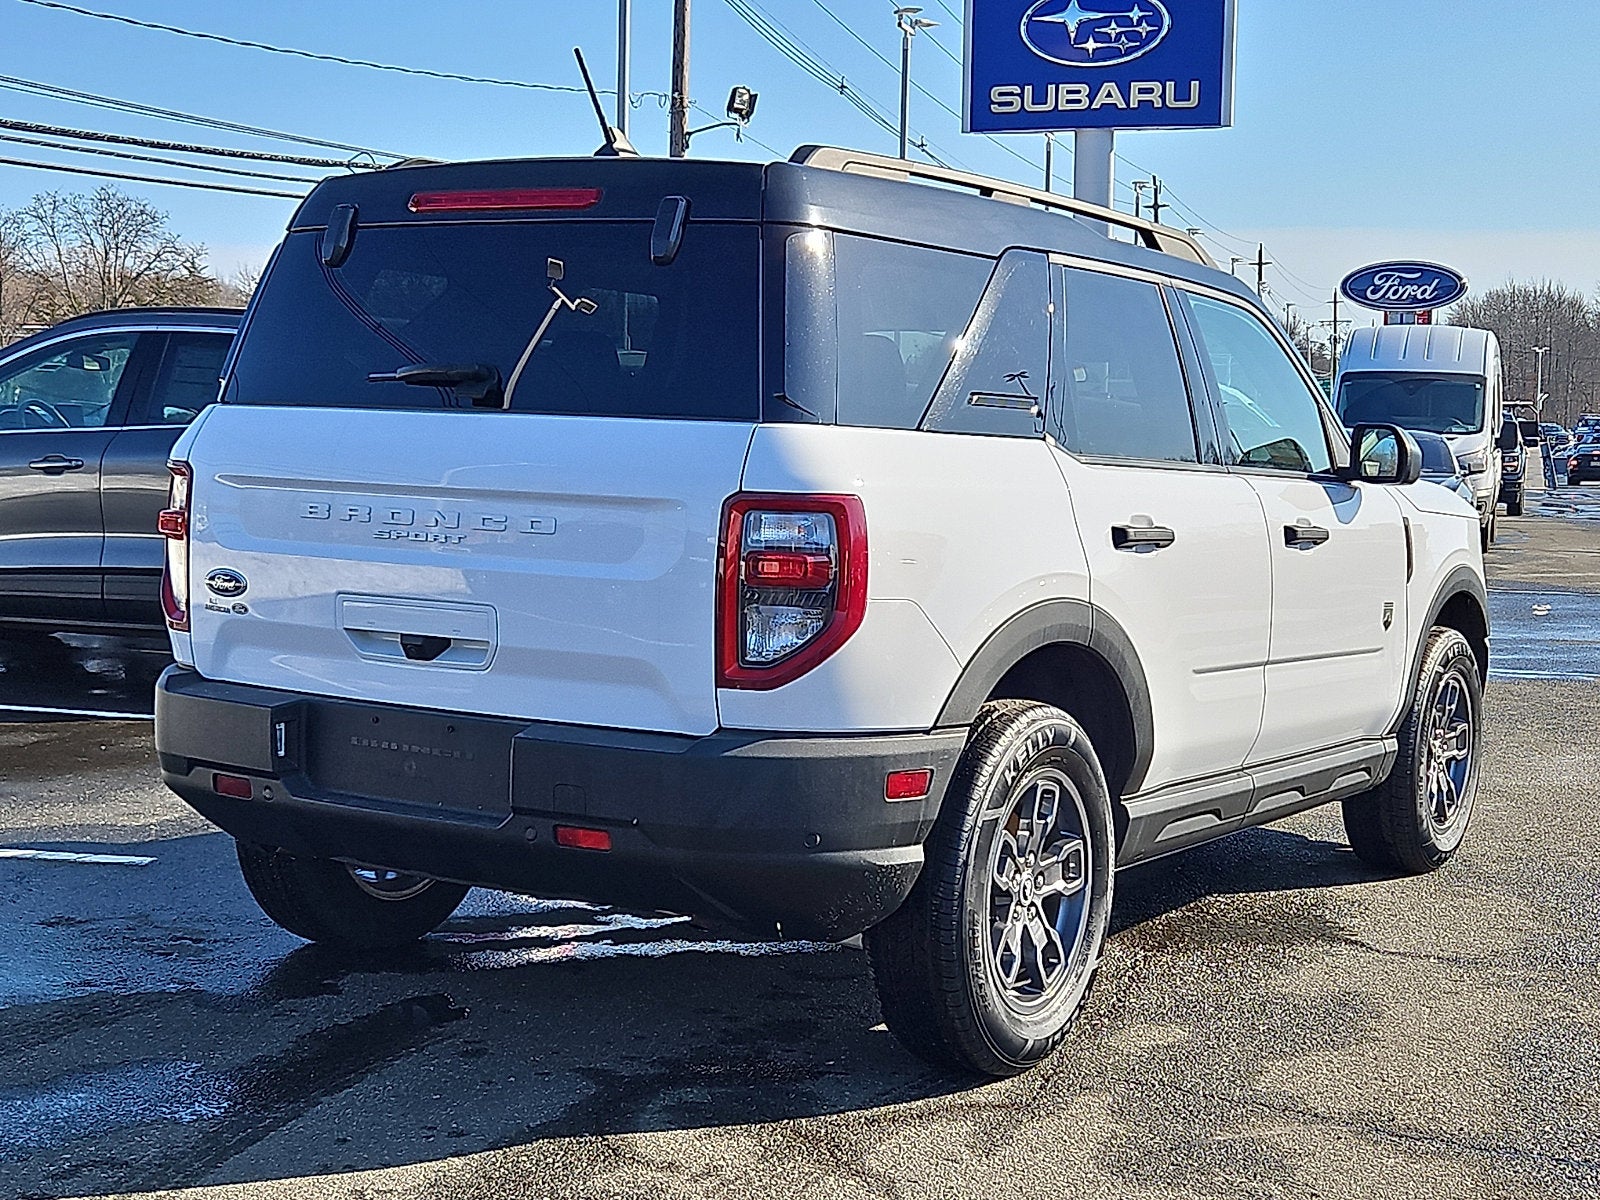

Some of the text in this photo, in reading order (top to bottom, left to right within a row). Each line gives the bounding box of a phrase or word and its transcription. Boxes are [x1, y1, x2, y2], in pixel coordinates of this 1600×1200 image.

[990, 80, 1200, 113] SUBARU
[1366, 271, 1440, 300] Ford
[300, 501, 558, 536] BRONCO
[373, 529, 467, 545] SPORT
[1447, 643, 1471, 660] KELLY
[1003, 726, 1056, 787] KELLY
